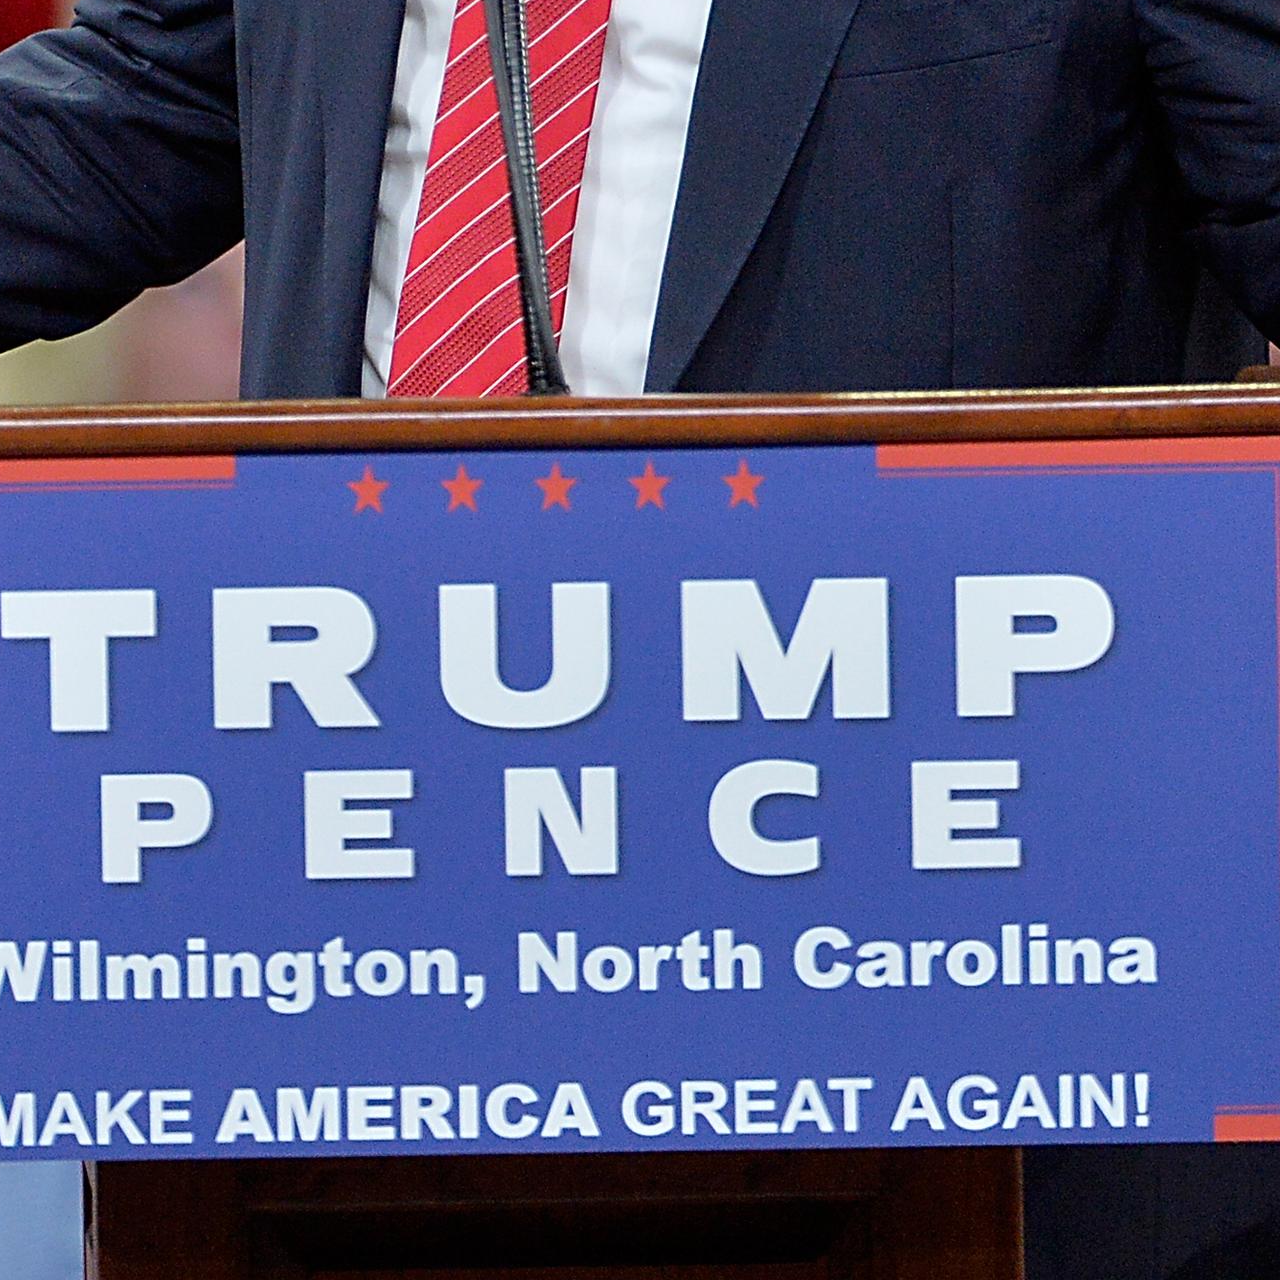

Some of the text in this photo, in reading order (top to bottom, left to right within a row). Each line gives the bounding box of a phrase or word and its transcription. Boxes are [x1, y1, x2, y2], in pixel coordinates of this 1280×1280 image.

[0, 574, 1116, 732] TRUMP
[99, 759, 1024, 884] PENCE
[518, 926, 762, 993] North
[793, 922, 1159, 989] Carolina
[214, 1081, 600, 1143] AMERICA
[621, 1077, 873, 1137] GREAT
[889, 1072, 1150, 1131] AGAIN!
